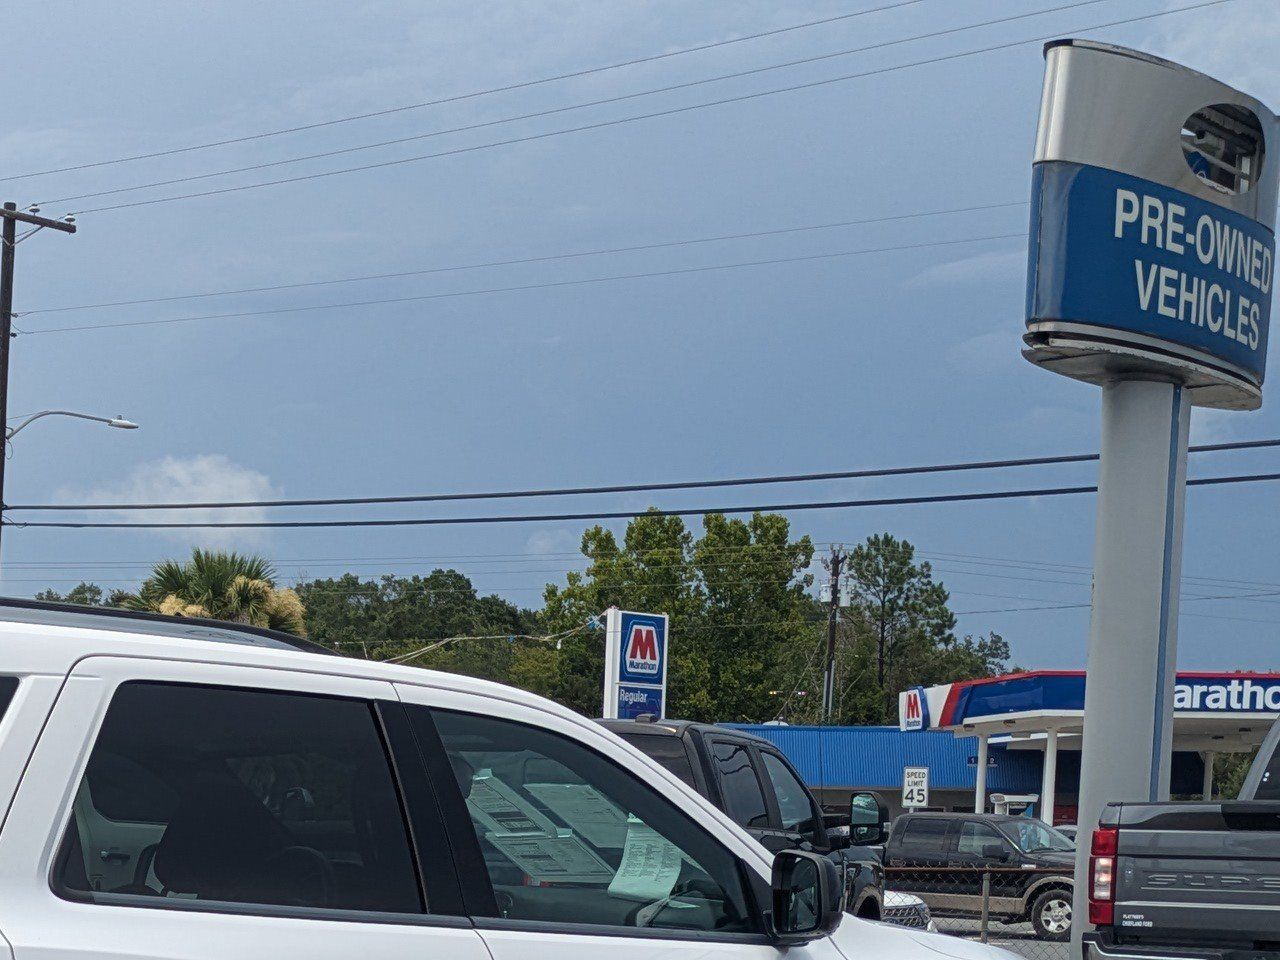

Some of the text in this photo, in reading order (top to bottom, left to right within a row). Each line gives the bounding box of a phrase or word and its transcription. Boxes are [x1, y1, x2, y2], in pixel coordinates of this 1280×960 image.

[1115, 188, 1271, 295] PRE-OWNED
[1134, 259, 1260, 351] VEHICLES
[628, 660, 657, 671] Marathon
[620, 689, 648, 703] Regular
[906, 771, 926, 779] SPEED
[904, 789, 925, 803] 45
